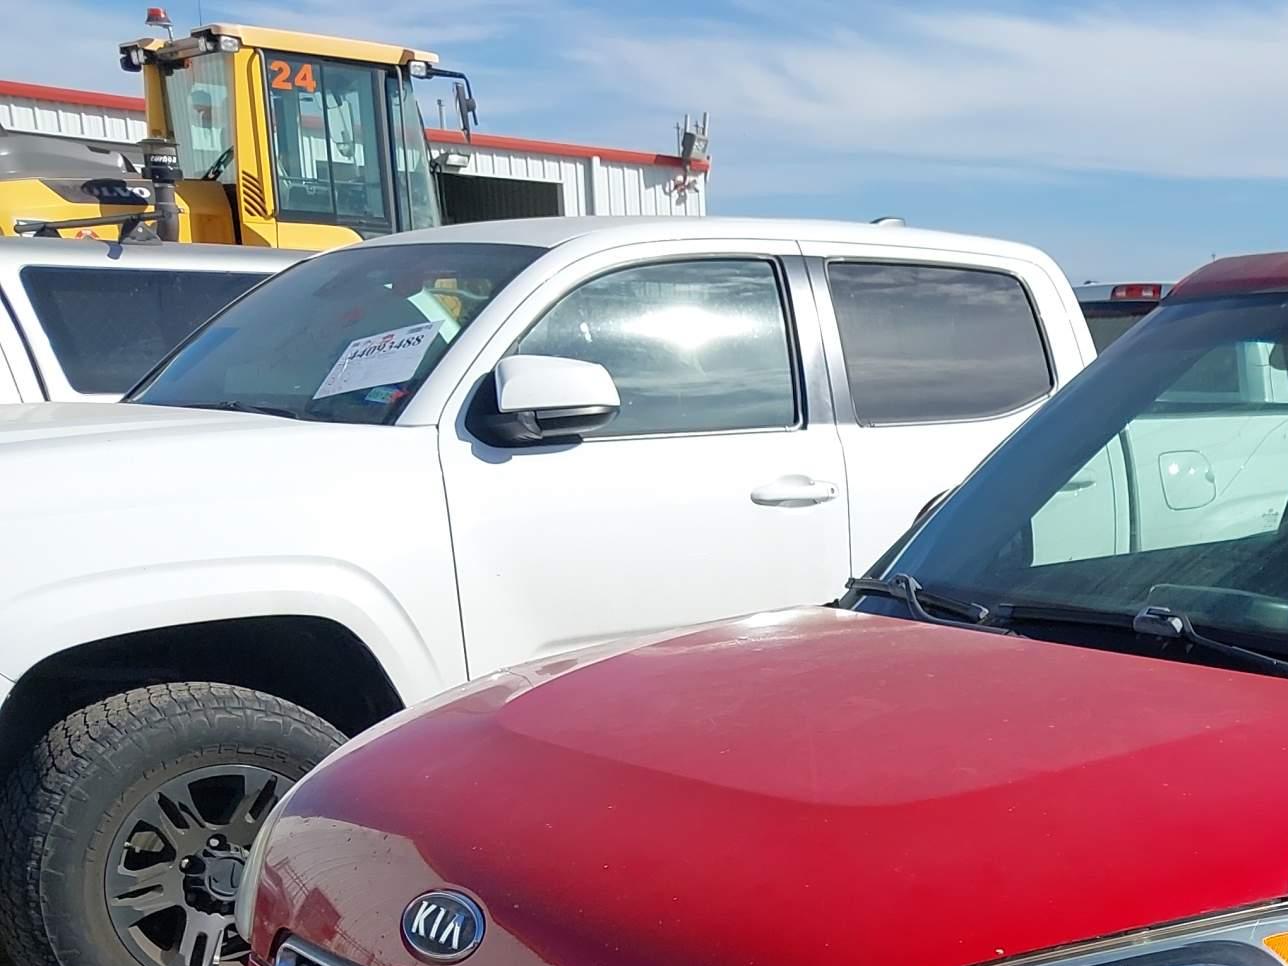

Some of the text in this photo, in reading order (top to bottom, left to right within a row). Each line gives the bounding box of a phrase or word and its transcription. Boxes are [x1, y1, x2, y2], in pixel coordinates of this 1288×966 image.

[271, 60, 317, 93] 24
[81, 184, 151, 200] OLVO
[411, 900, 465, 950] KIA
